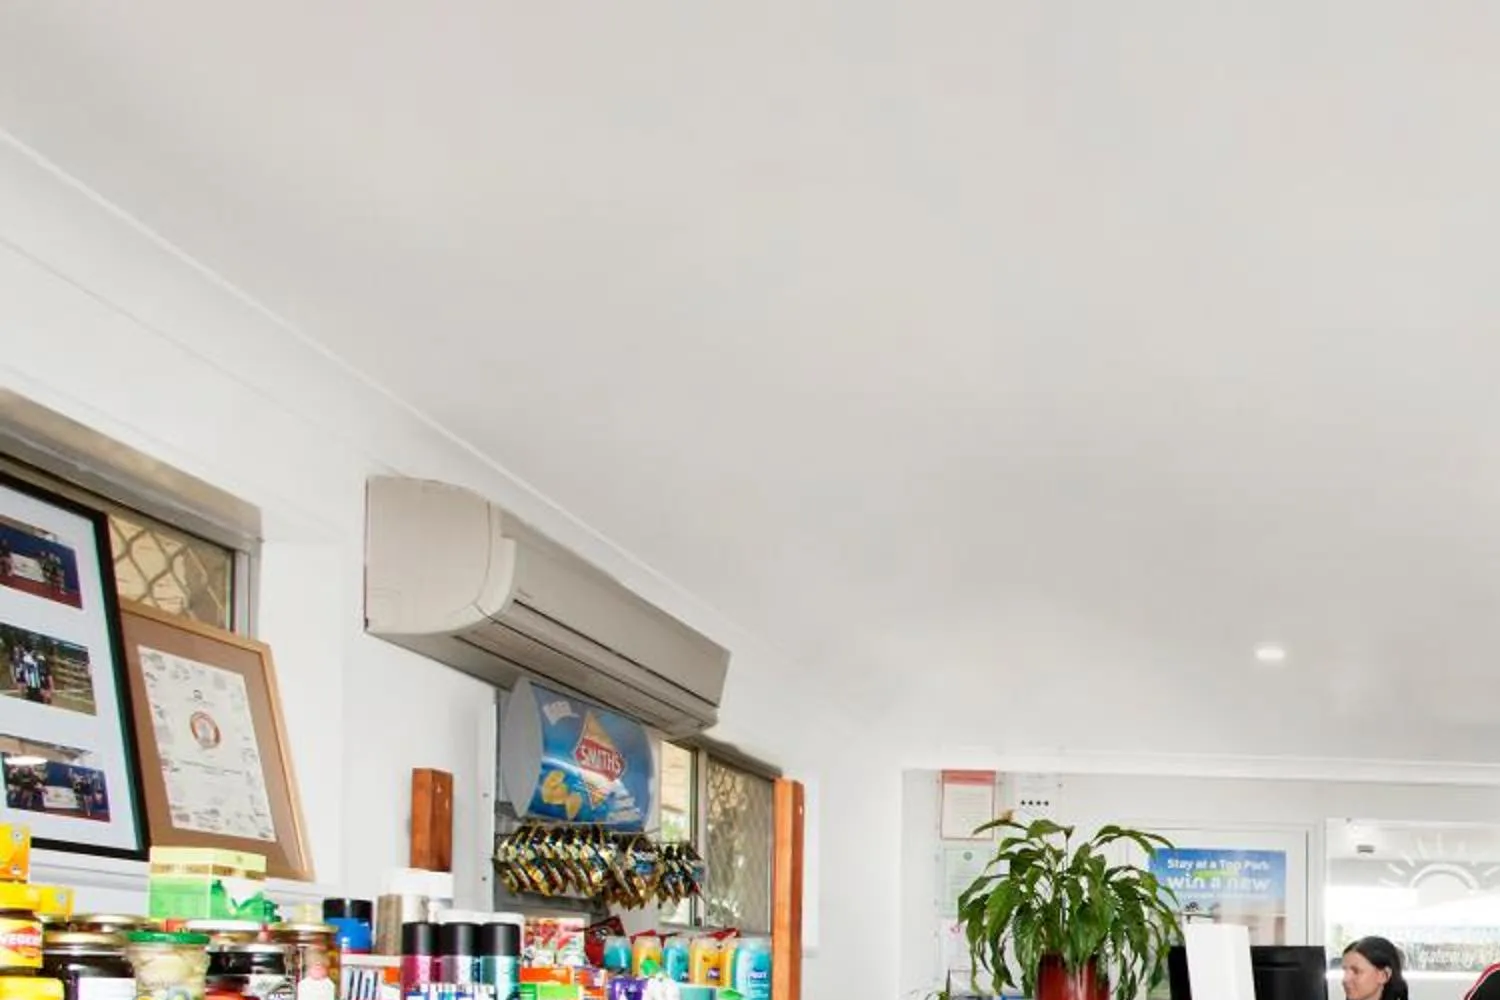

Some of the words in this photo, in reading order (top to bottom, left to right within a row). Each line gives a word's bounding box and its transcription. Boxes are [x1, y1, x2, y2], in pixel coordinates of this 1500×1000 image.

[1168, 876, 1205, 890] win
[1210, 879, 1220, 890] a
[1228, 879, 1271, 891] new
